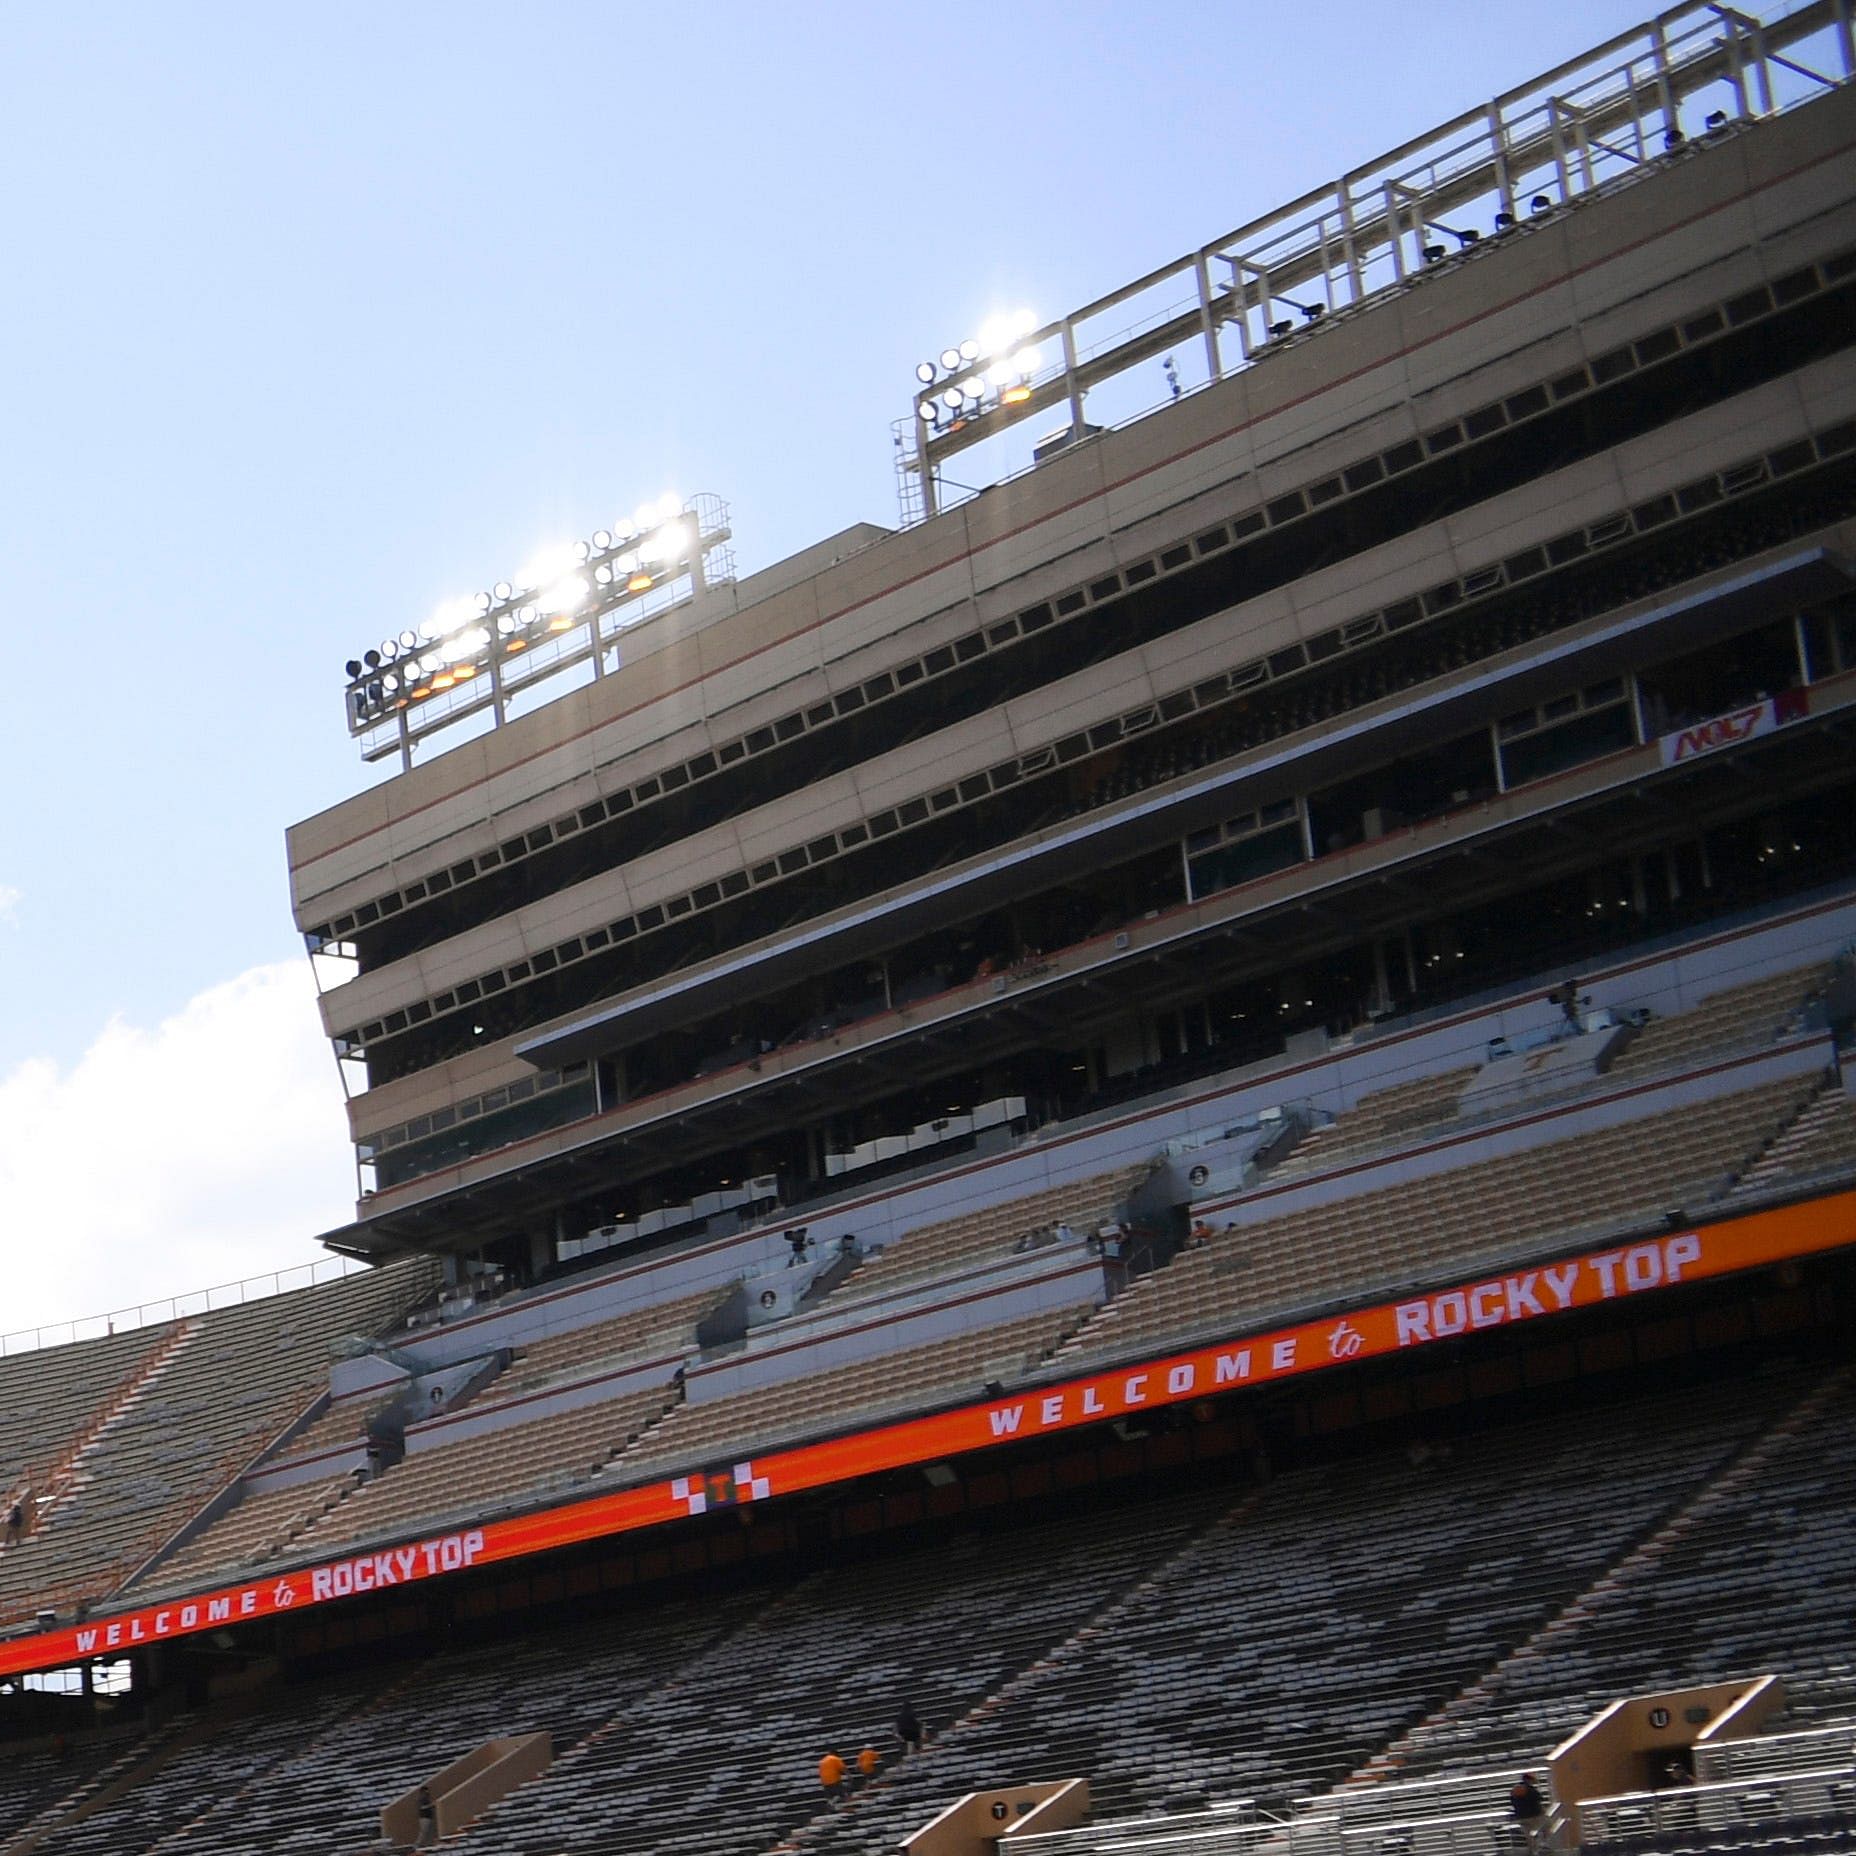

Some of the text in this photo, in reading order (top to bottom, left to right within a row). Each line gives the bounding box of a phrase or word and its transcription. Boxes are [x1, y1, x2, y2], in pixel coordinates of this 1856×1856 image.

[988, 1235, 1702, 1437] WELCOME to ROCKY TOP
[76, 1530, 485, 1653] WELCOME to ROCKY TOP
